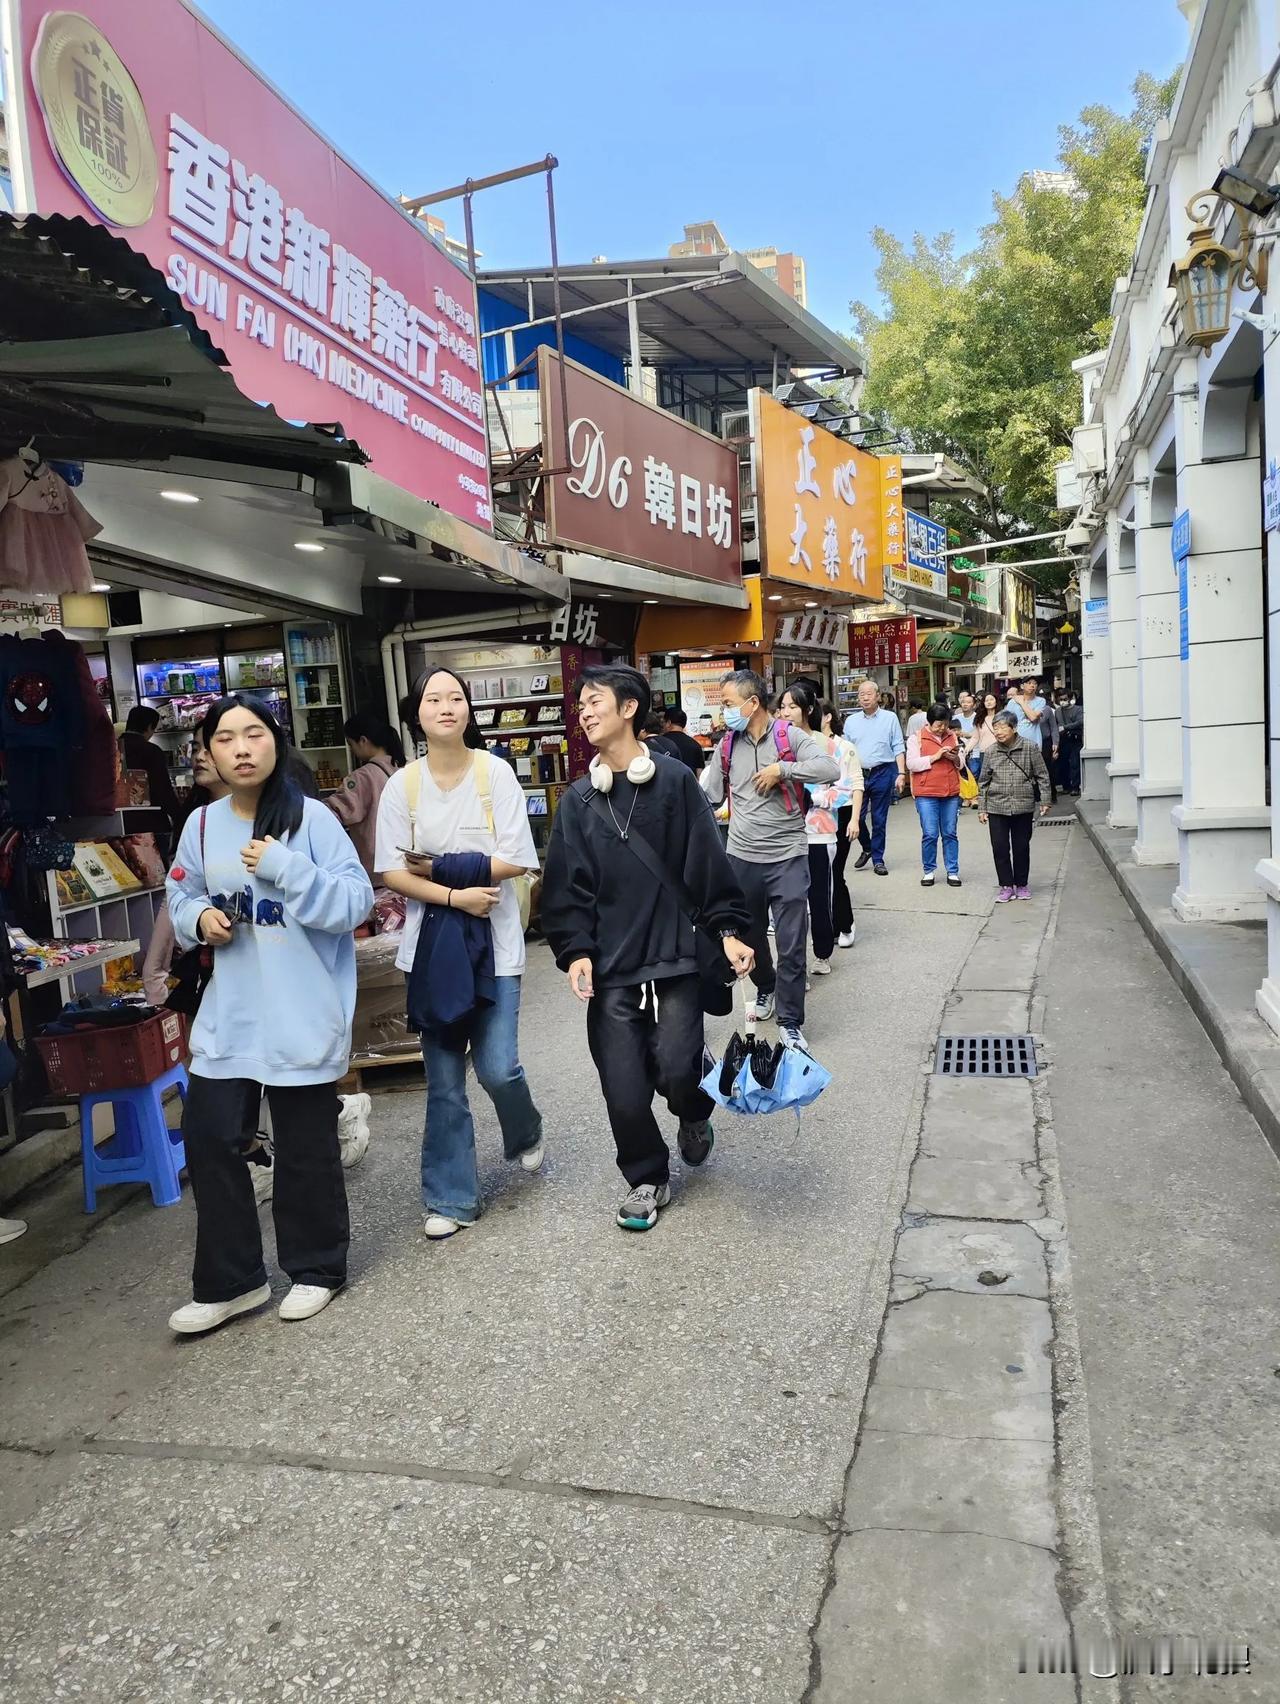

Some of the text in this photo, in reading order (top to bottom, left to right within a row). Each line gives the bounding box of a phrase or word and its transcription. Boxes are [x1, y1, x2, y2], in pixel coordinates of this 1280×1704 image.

[72, 56, 125, 133] 正貨
[91, 159, 124, 190] 100%
[168, 112, 438, 388] 香港新輝藥行
[166, 254, 228, 321] SUN
[236, 294, 276, 348] FAI
[284, 323, 326, 380] (HK)
[328, 350, 409, 425] MEDICINE
[440, 370, 483, 419] 有限公司
[566, 417, 732, 549] D6 韓日坊
